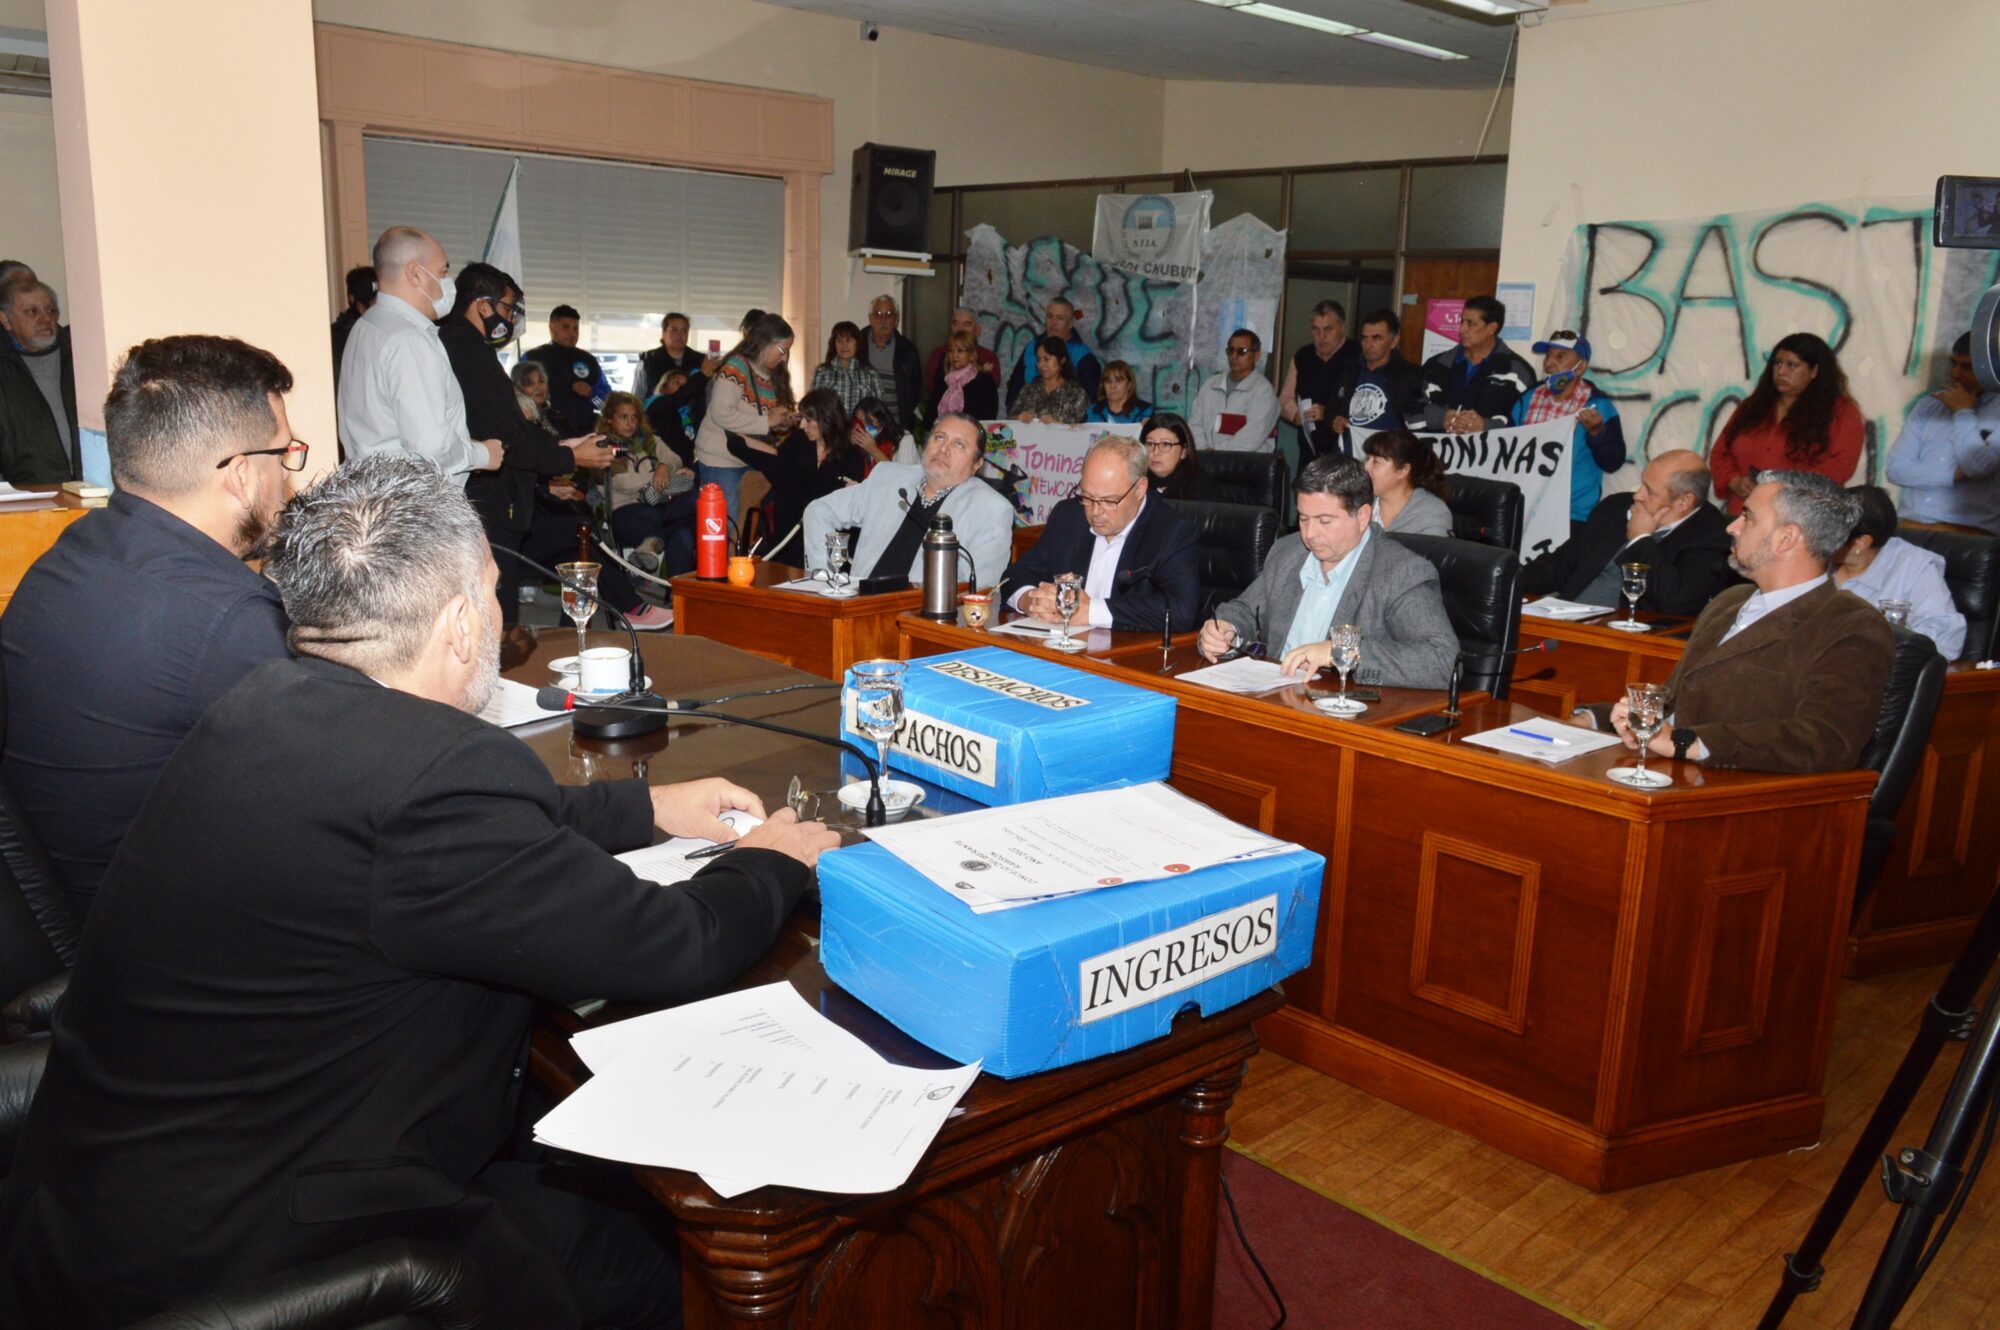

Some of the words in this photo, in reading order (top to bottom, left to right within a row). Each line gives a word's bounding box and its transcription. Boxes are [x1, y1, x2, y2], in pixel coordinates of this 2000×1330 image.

[883, 167, 917, 178] MIRAGE
[1577, 203, 1999, 379] BAST
[1020, 444, 1083, 474] Tonina
[1028, 475, 1080, 498] NEWCO
[935, 661, 1080, 709] DESPACHOS
[855, 697, 982, 774] PACHOS
[1084, 907, 1275, 1011] INGRESOS
